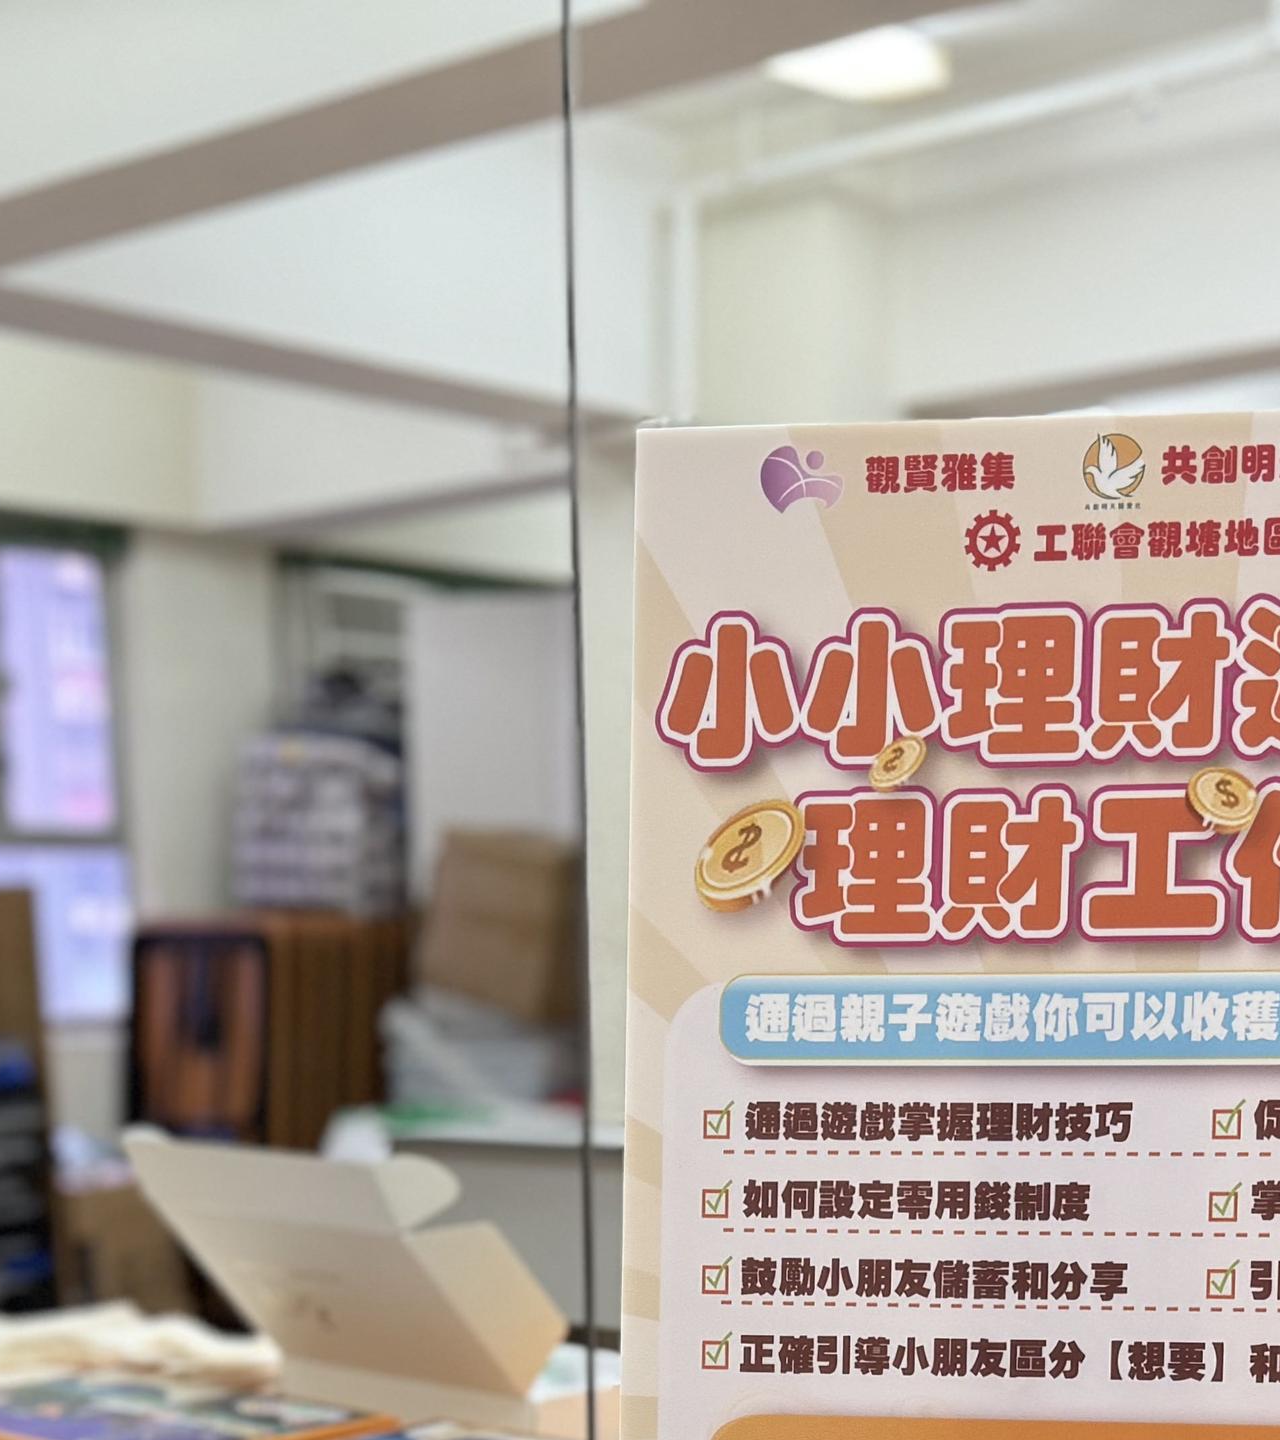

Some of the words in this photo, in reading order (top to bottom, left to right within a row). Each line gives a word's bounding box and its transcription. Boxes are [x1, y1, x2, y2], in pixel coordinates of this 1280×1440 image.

[866, 453, 1016, 495] 觀賢雅集
[743, 990, 1280, 1043] 通過親子遊戲你可以收穫
[744, 1100, 1134, 1144] 通過遊戲掌握理財技巧
[742, 1179, 1092, 1222] 如何設定零用錢制度
[740, 1256, 1129, 1301] 鼓勵小朋友儲蓄和分享
